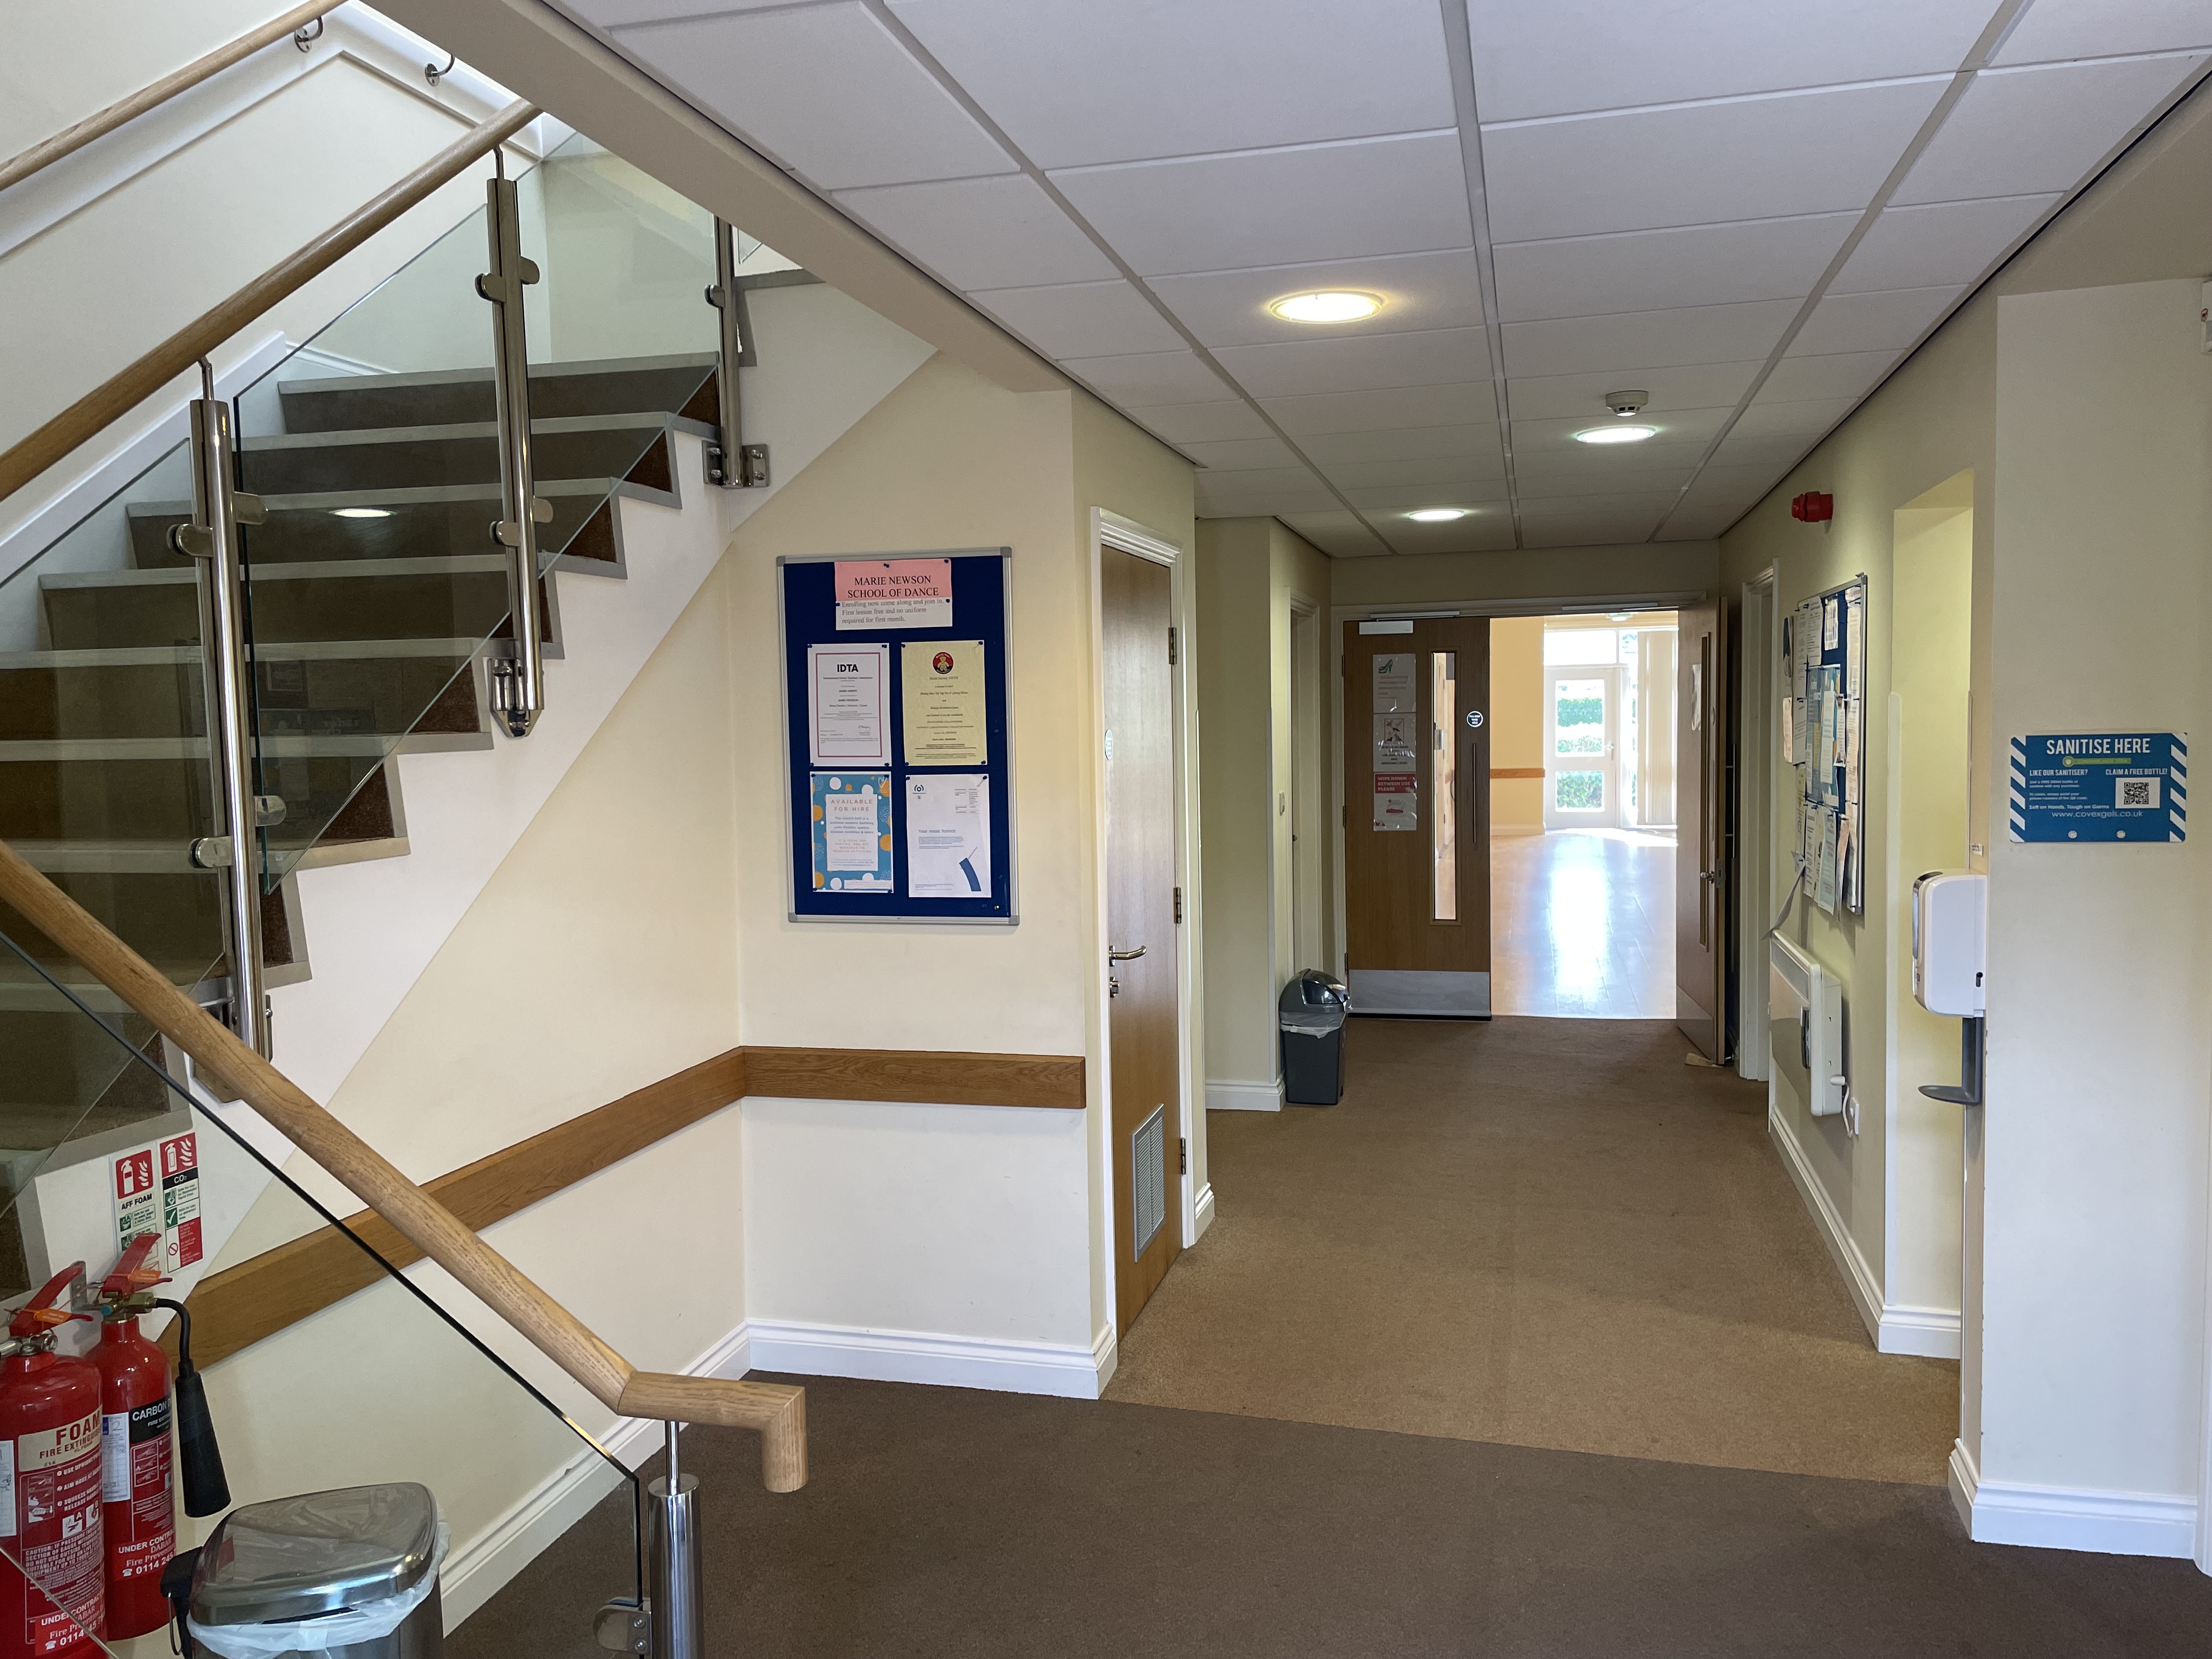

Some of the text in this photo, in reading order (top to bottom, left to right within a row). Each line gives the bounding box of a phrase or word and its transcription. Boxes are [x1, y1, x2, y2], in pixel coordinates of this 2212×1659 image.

[854, 575, 932, 586] MARIE NEWSON
[848, 588, 939, 598] SCHOOL OF DANCE
[837, 664, 859, 673] IDTA
[2046, 738, 2151, 754] SANITISE HERE
[2051, 810, 2143, 819] www.covexgels.co.uk
[121, 1193, 153, 1210] AFF FOAM
[132, 1402, 167, 1421] CARBON
[56, 1409, 100, 1446] FOAM
[40, 1446, 62, 1459] FIRE
[76, 1511, 82, 1521] A
[119, 1542, 148, 1554] UNDER
[126, 1558, 143, 1567] Fire
[136, 1561, 160, 1575] 0114
[50, 1628, 67, 1639] Fire
[60, 1629, 84, 1646] 0114
